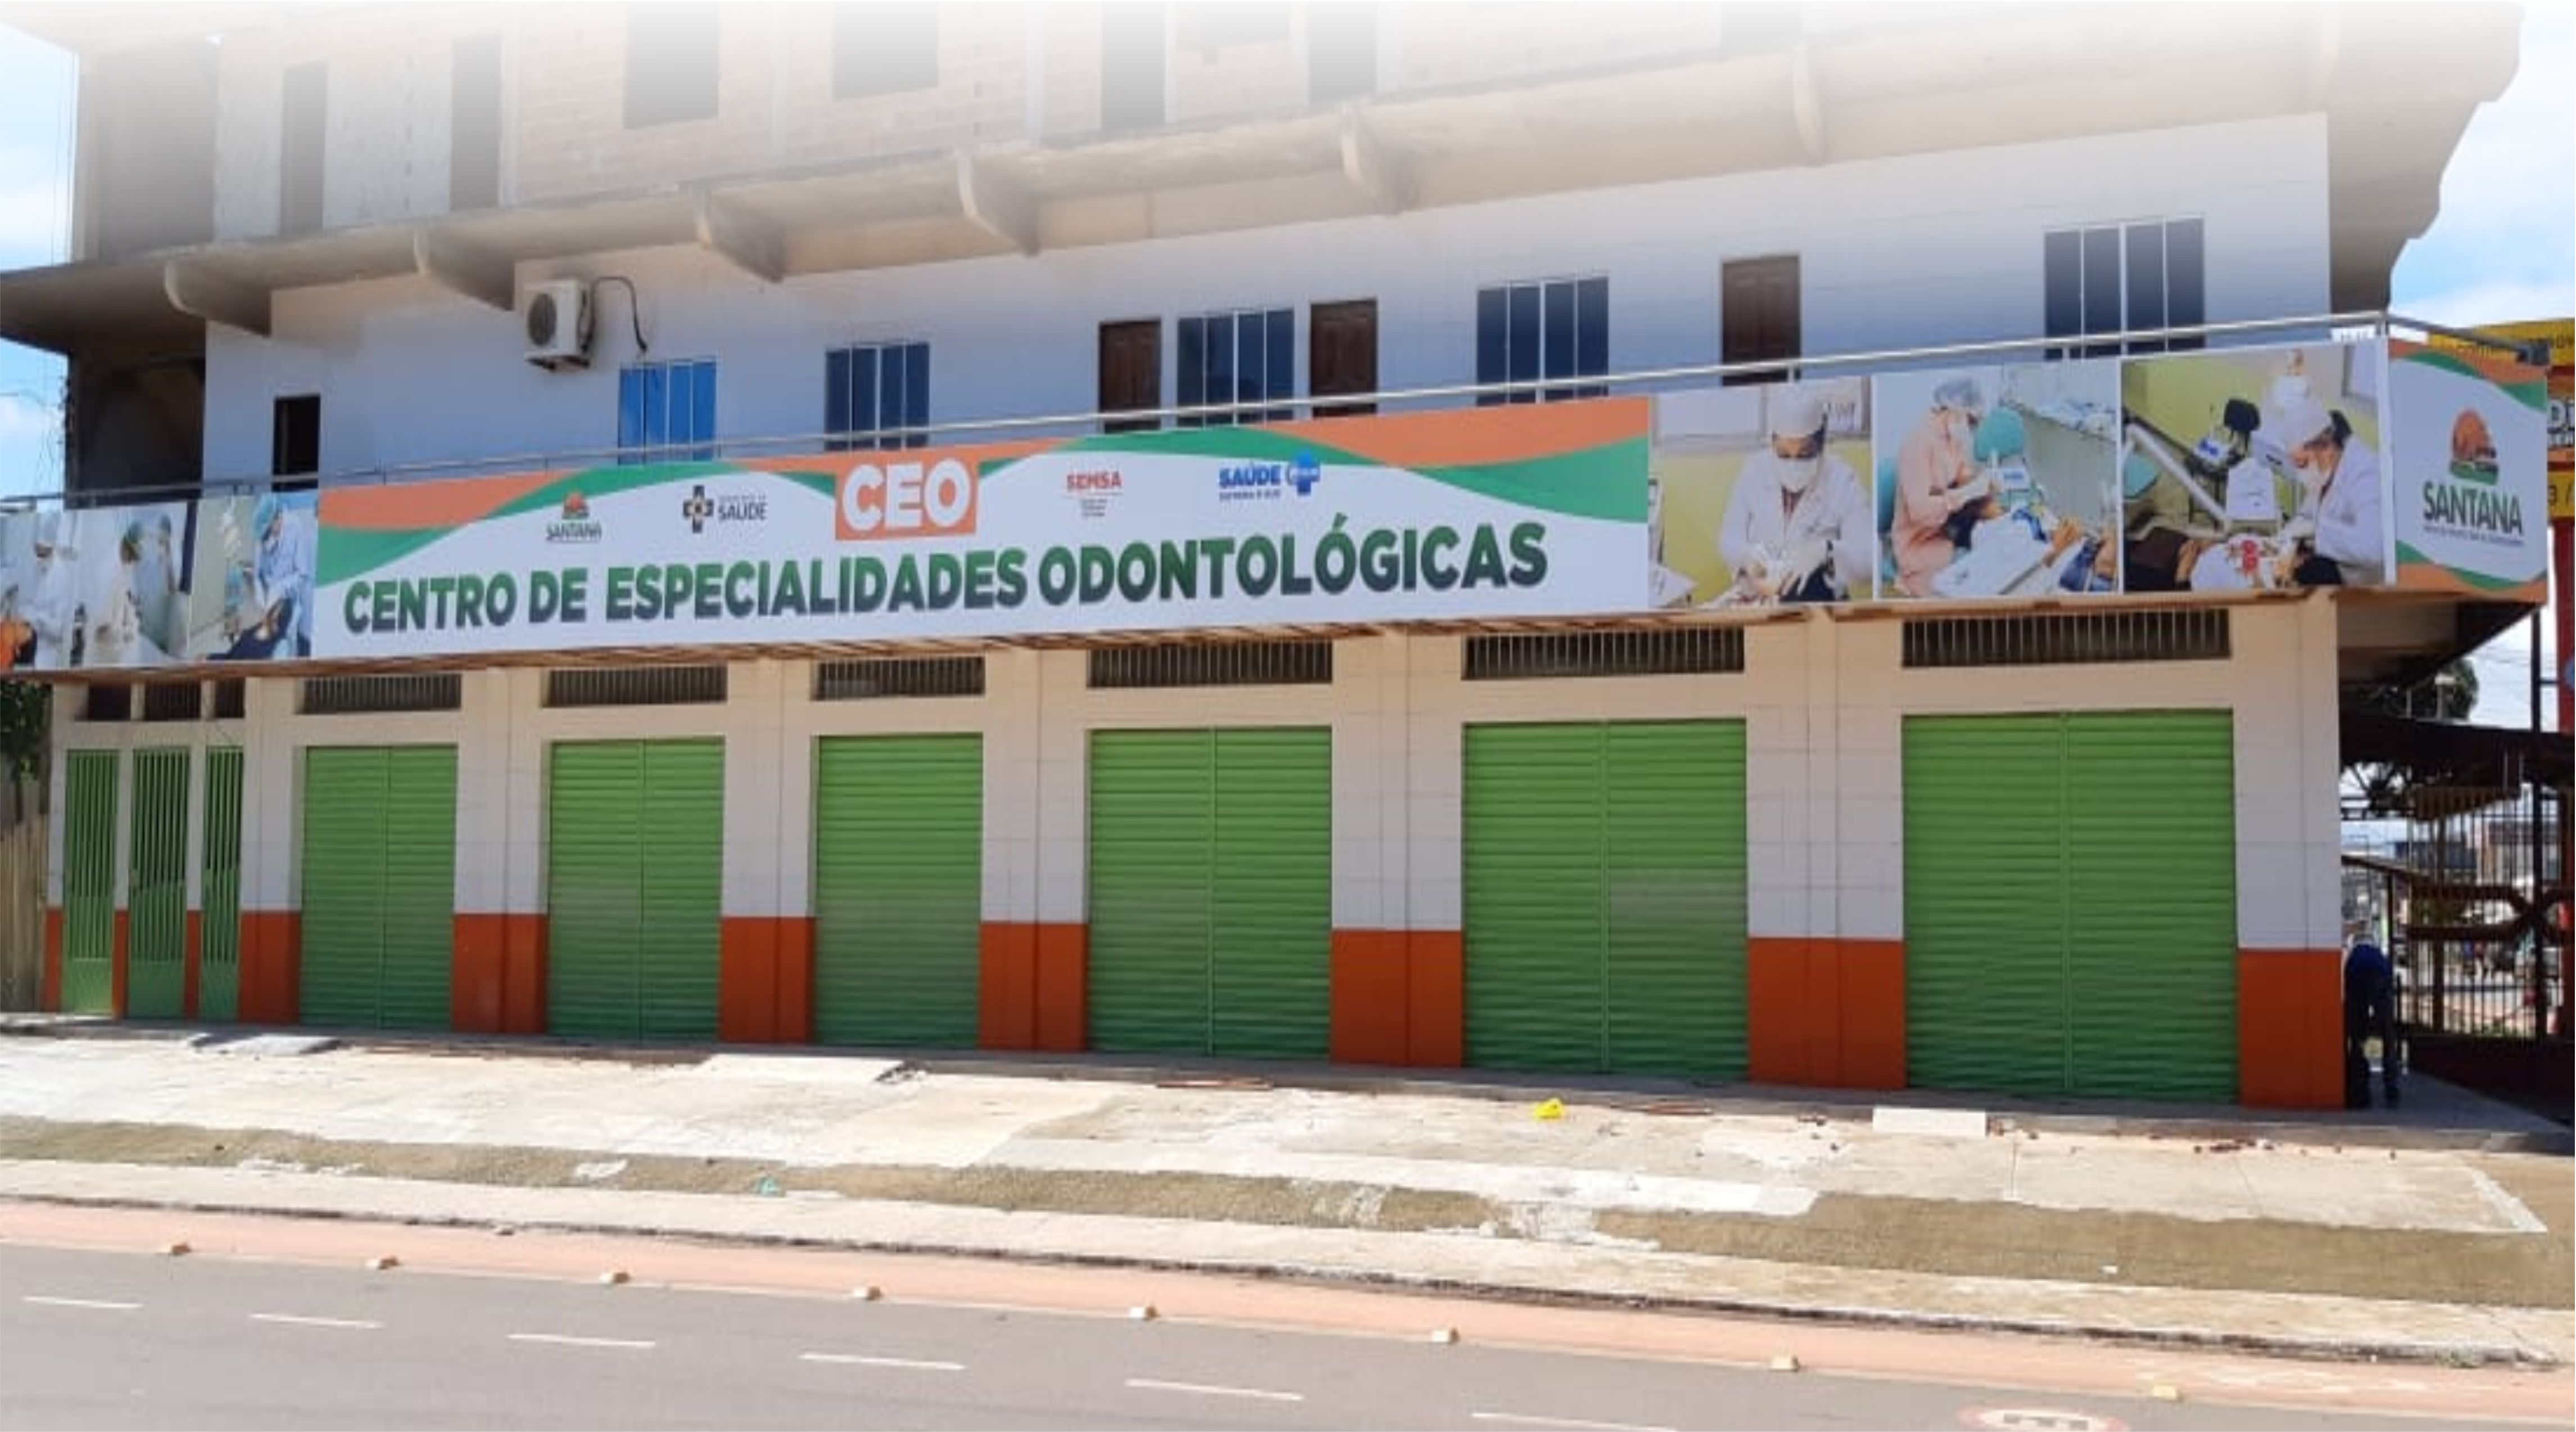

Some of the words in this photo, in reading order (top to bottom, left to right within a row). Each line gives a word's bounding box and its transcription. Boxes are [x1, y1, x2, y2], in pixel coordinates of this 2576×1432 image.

[843, 458, 971, 531] CEO
[2424, 481, 2523, 536] SANTANA
[344, 572, 517, 633] CENTRO
[529, 568, 588, 623] DE
[606, 548, 1027, 621] ESPECIALIDADES
[1038, 513, 1547, 606] ODONTOLÓGICAS
